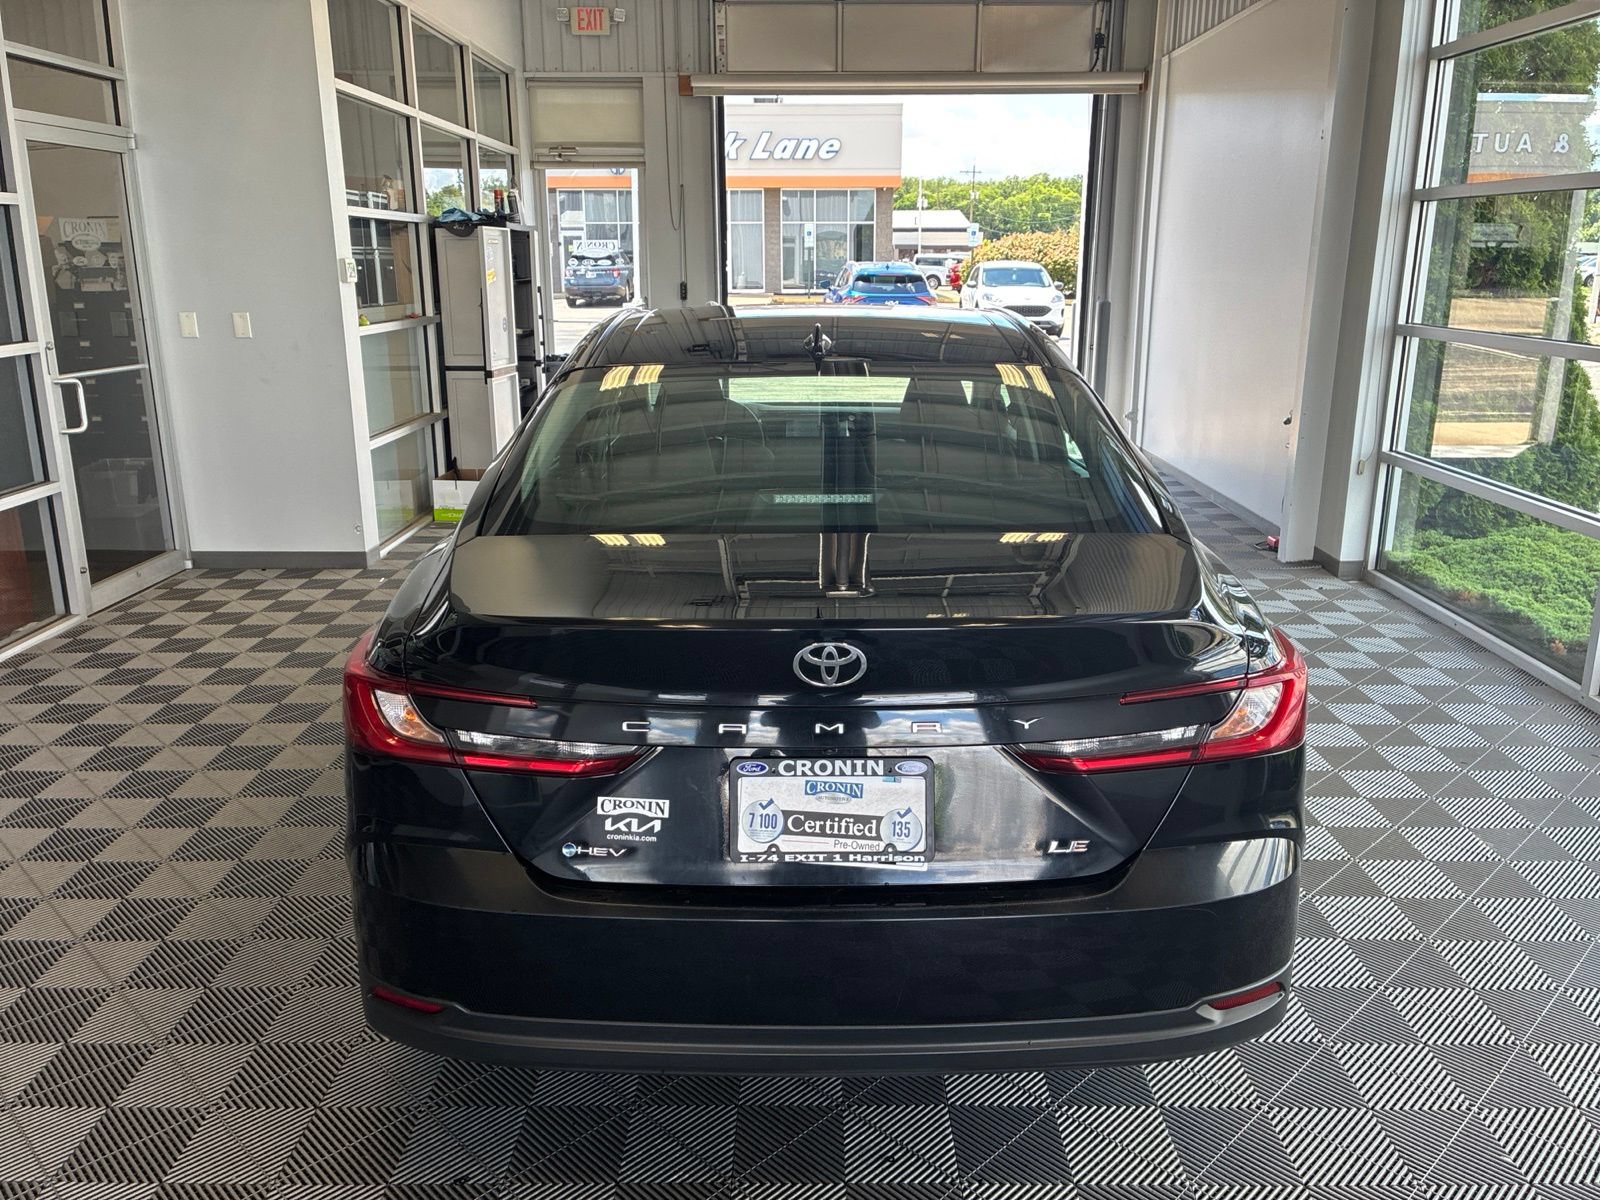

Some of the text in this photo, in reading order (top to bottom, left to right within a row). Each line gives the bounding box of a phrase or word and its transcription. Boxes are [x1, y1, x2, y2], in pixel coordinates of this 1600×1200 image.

[577, 7, 604, 31] EXIT
[750, 131, 842, 160] Lane
[621, 717, 1044, 734] CAMRY
[778, 759, 884, 775] CRONIN
[806, 781, 862, 798] CRONIN
[600, 798, 666, 816] CRONIN
[604, 817, 662, 833] KIA
[759, 813, 777, 829] 100
[787, 814, 877, 837] Certified
[606, 833, 657, 842] croninkia.com
[892, 821, 911, 838] 135
[576, 847, 627, 857] HEV
[833, 839, 880, 851] Pre-Owned
[1047, 840, 1090, 853] LE
[740, 854, 925, 862] I-74 EXIT 1 Harrison
